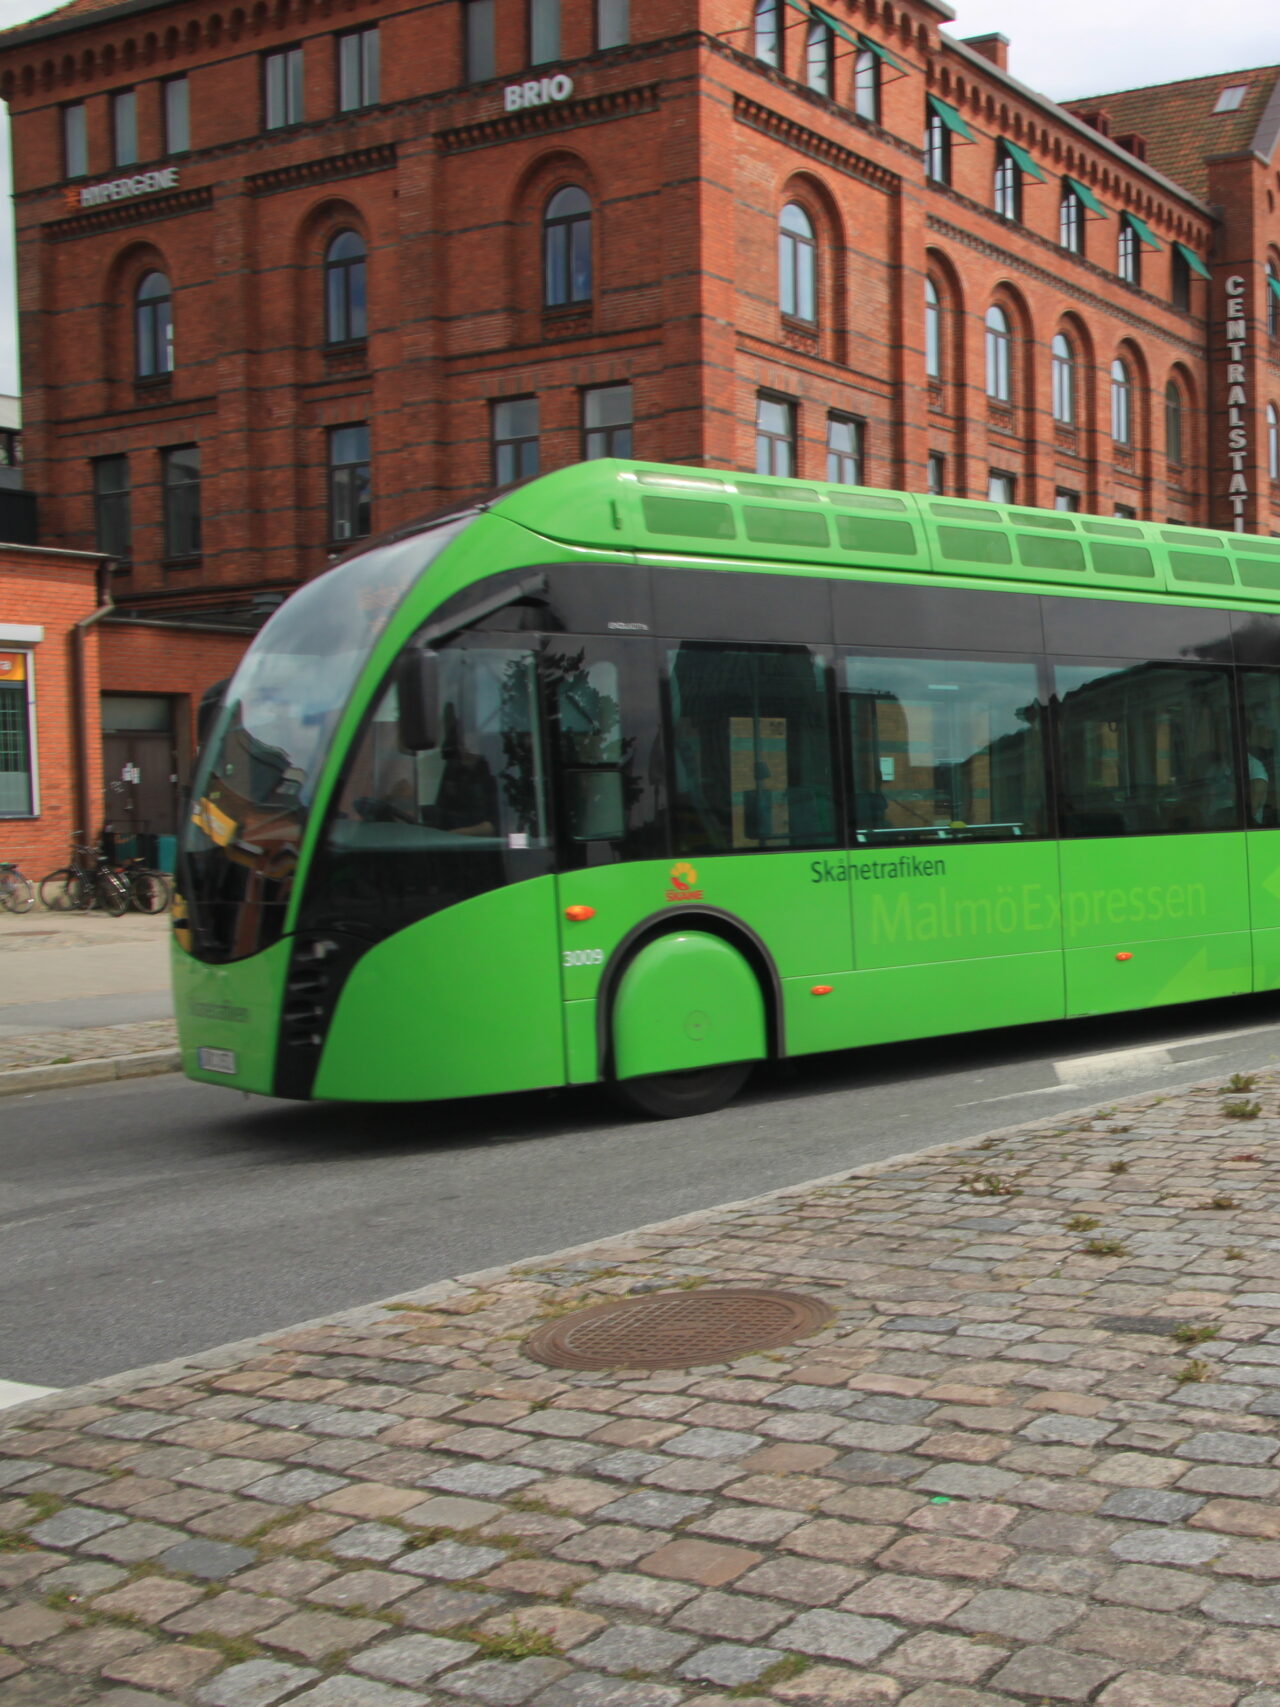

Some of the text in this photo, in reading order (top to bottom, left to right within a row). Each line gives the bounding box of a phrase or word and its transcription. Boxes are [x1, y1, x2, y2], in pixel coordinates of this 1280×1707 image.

[504, 74, 573, 112] BRIO
[80, 167, 179, 207] HYPERGENE
[810, 855, 945, 884] Skånetrafiken
[869, 882, 1206, 945] MalmöExpressen
[563, 949, 604, 967] 3009
